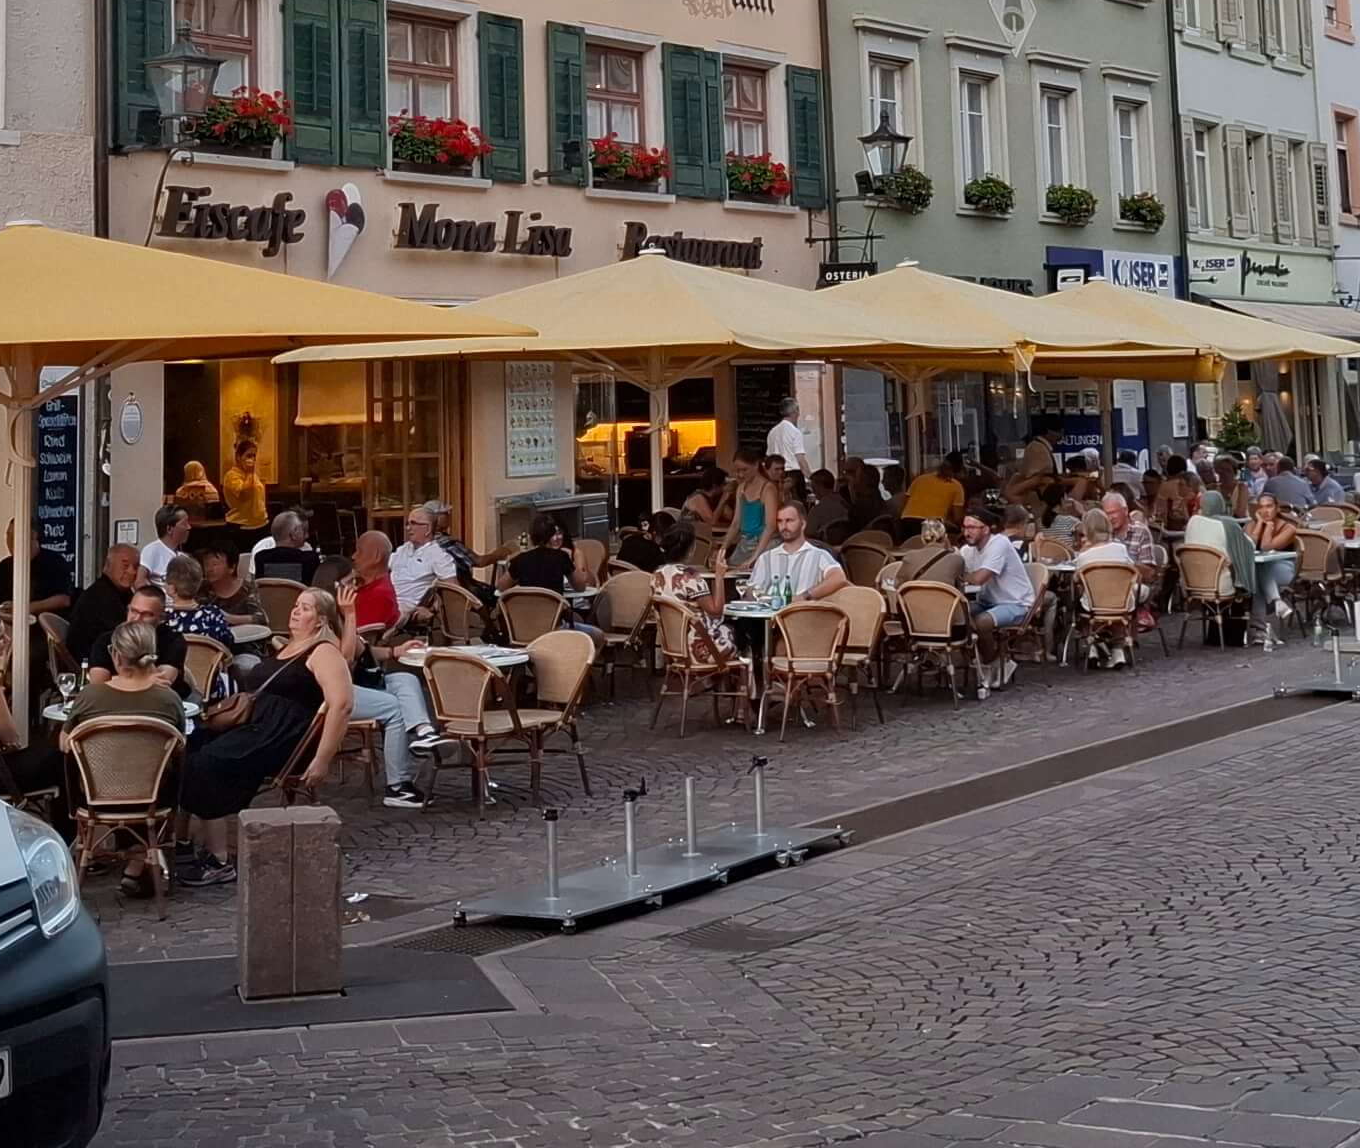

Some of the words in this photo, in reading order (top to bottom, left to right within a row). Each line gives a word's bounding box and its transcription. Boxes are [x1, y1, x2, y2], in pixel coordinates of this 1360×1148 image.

[395, 202, 497, 253] Mona
[500, 210, 573, 258] Lisa
[825, 269, 871, 282] OSTERIA
